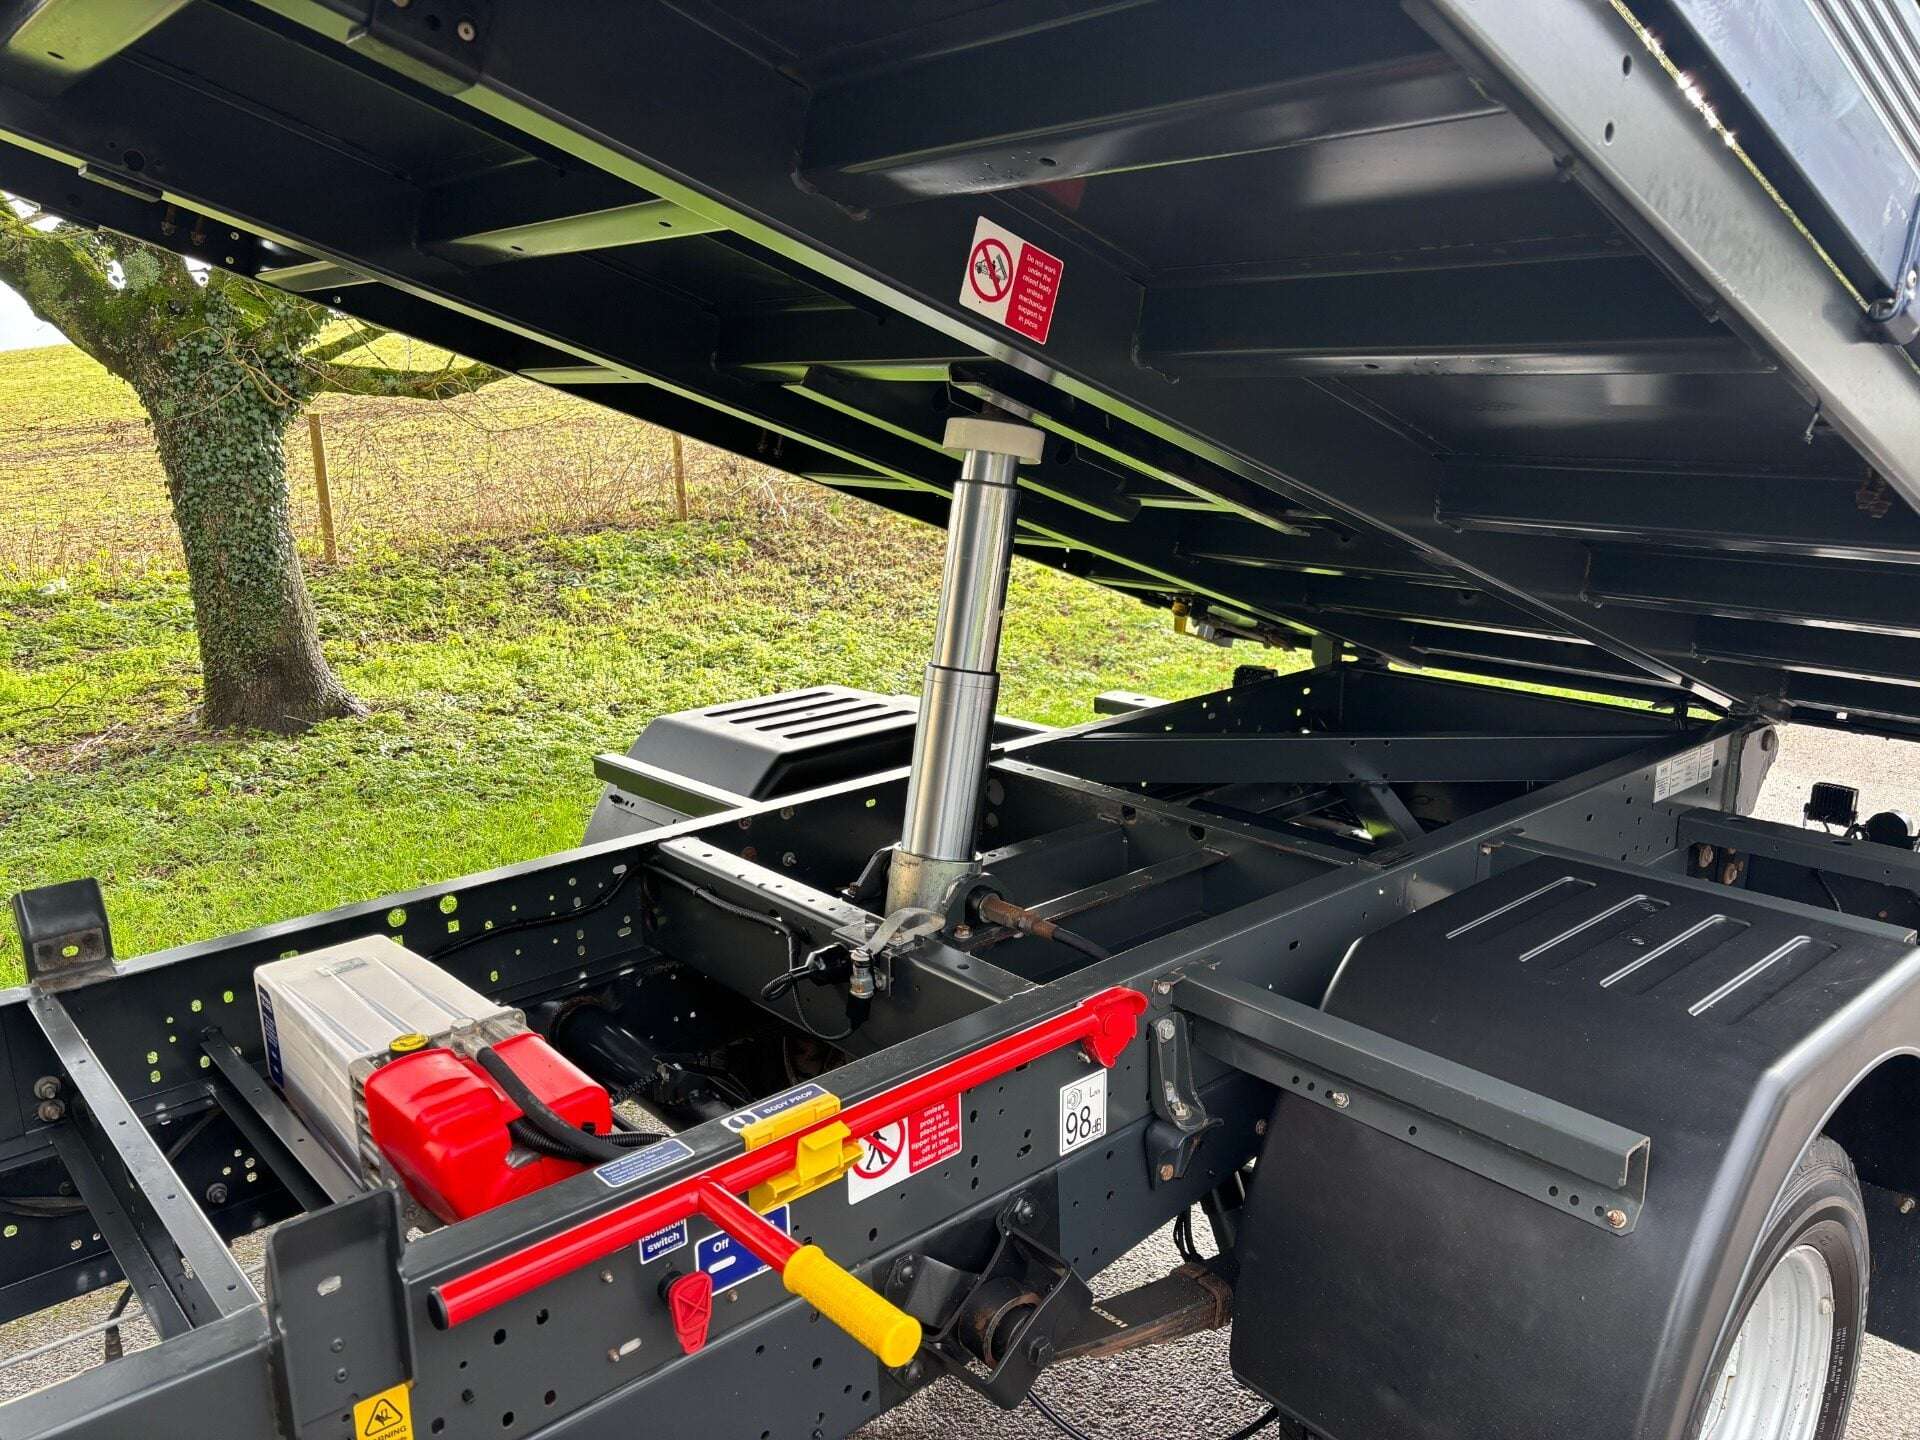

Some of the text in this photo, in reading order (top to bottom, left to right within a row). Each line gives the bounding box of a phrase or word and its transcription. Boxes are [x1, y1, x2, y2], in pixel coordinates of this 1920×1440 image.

[1027, 266, 1042, 277] under
[1044, 264, 1056, 275] work
[1022, 275, 1052, 295] raised body
[1018, 294, 1047, 312] mechanical
[763, 1090, 813, 1114] BODY PROP
[923, 1103, 945, 1117] unless
[919, 1117, 935, 1131] prop
[919, 1118, 950, 1139] place and
[938, 1123, 959, 1138] turned
[1066, 1105, 1102, 1145] 98 dB
[921, 1144, 931, 1155] off
[937, 1141, 958, 1156] switch
[647, 1232, 680, 1253] switch
[712, 1238, 730, 1253] Off
